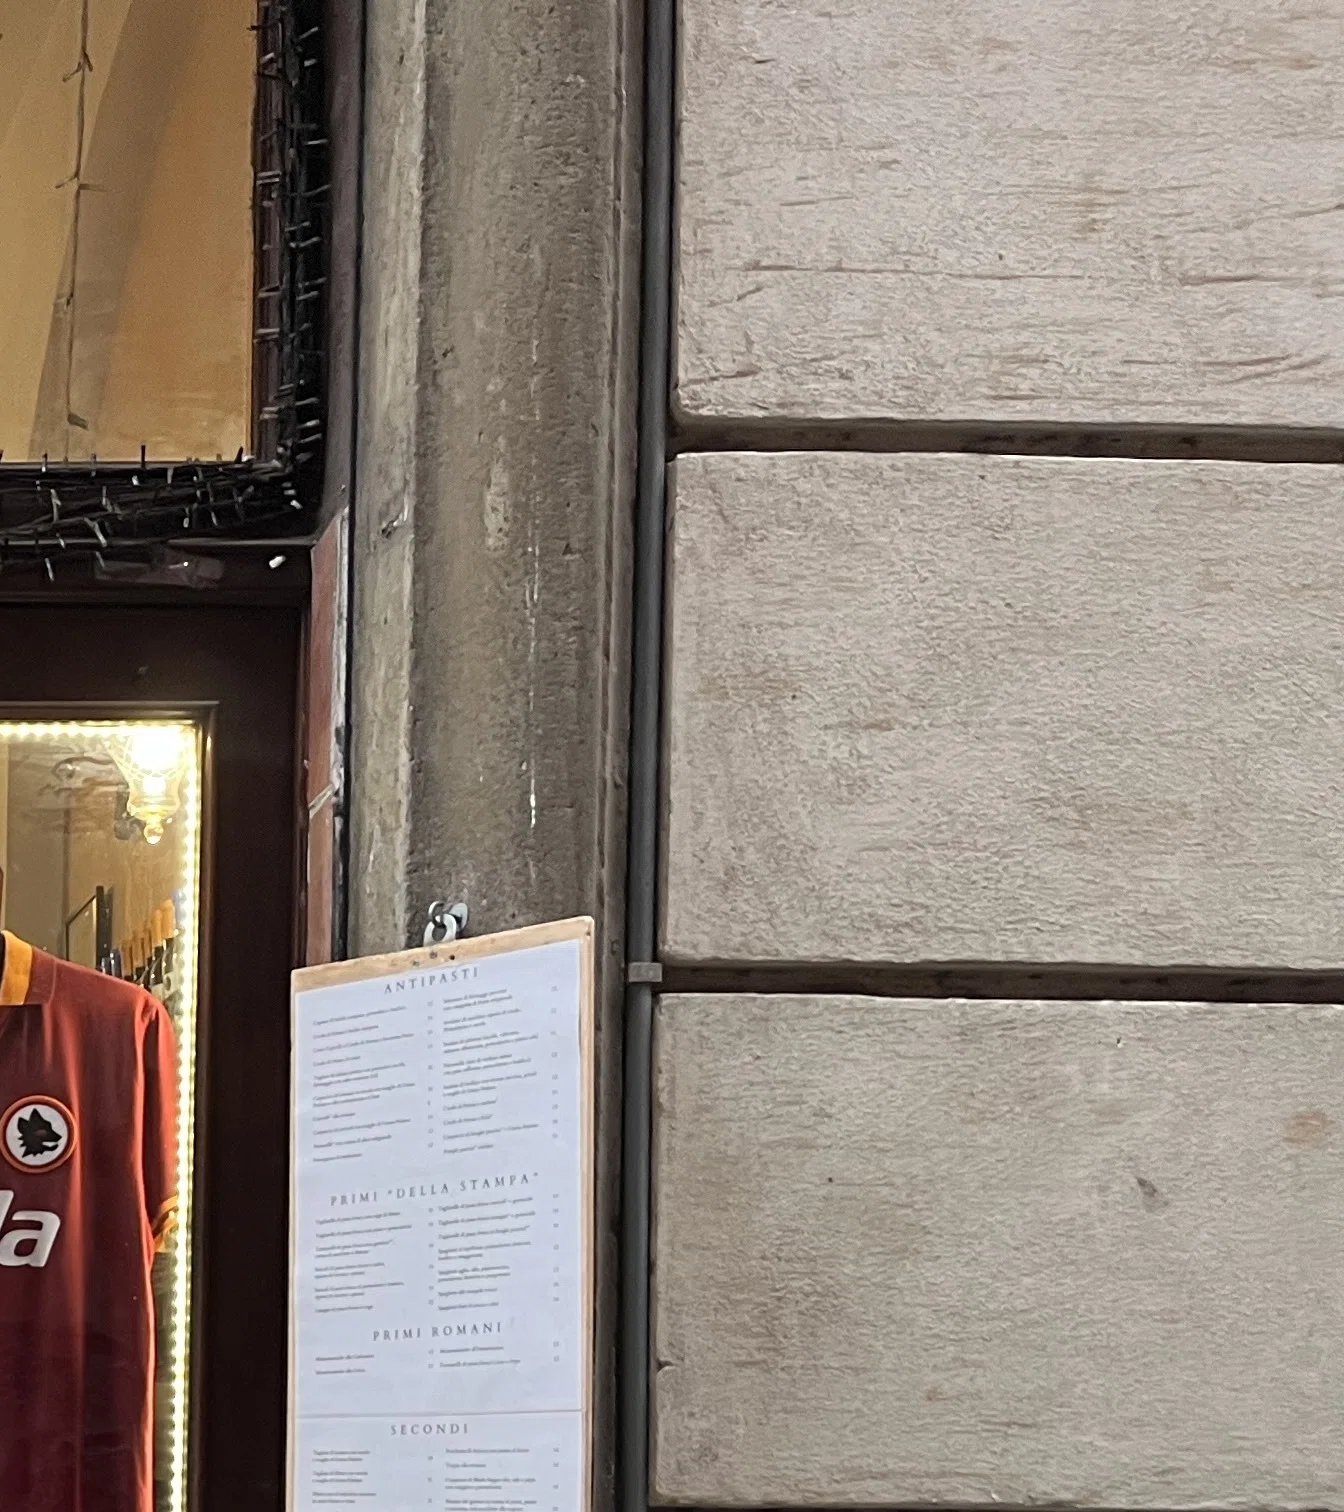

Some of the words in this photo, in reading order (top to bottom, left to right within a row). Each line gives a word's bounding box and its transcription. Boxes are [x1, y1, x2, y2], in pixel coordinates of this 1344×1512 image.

[384, 967, 480, 994] ANTIPASTI
[330, 1190, 378, 1206] PRIMI
[372, 1326, 423, 1342] PRIMI
[431, 1321, 503, 1338] ROMANI
[390, 1423, 470, 1437] SECONDI
